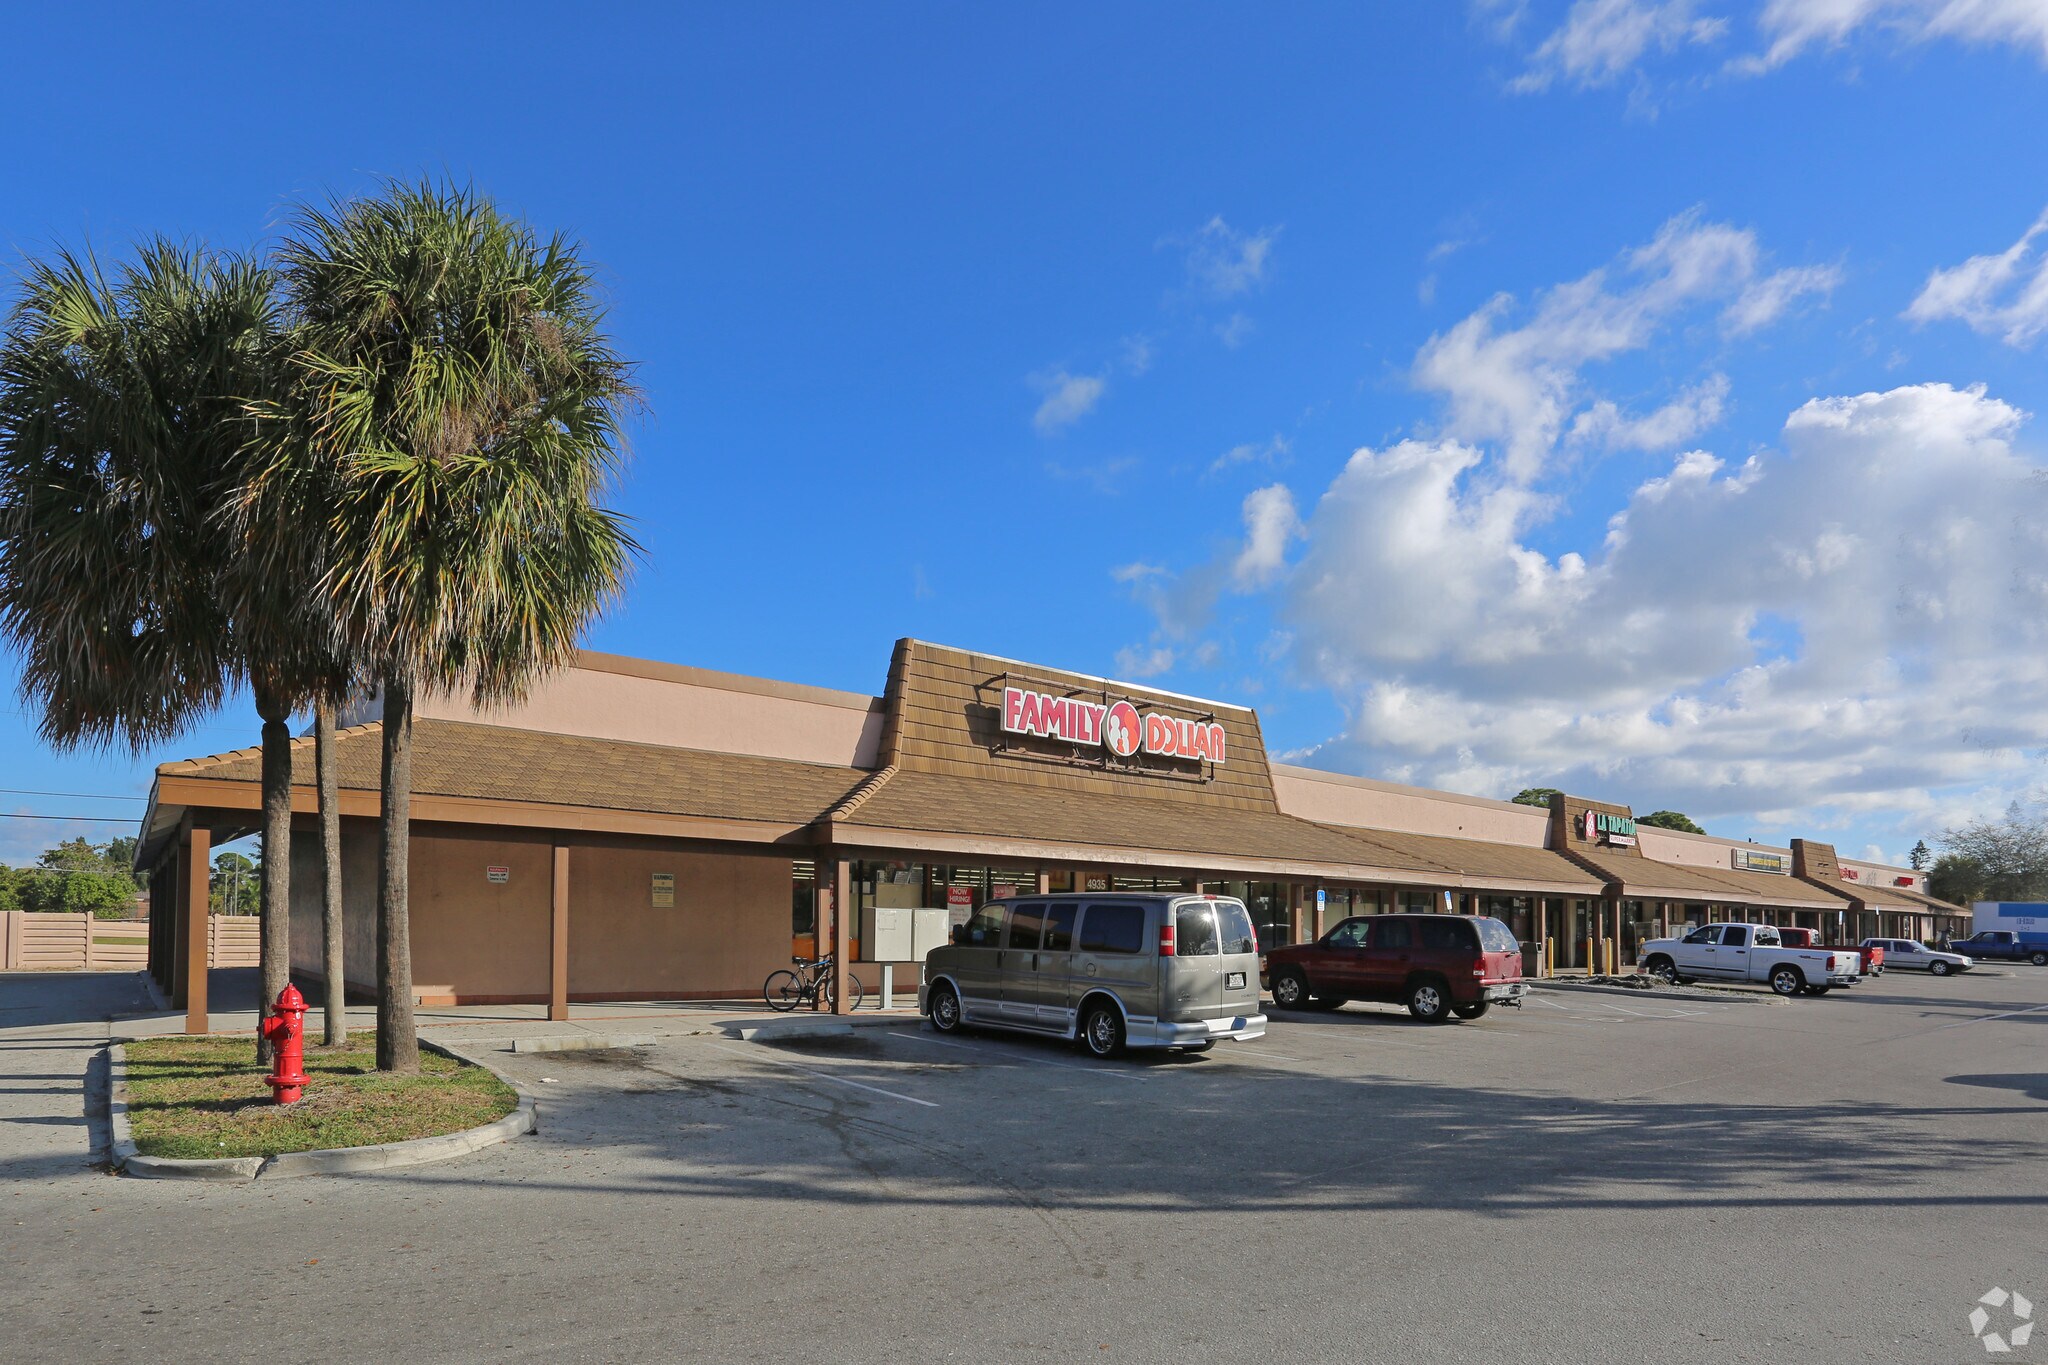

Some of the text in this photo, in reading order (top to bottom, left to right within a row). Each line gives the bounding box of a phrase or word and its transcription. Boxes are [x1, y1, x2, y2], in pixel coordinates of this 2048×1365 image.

[1005, 690, 1225, 762] FAMILY DOLLAR
[1597, 813, 1607, 832] LA
[1087, 878, 1106, 890] 4935
[949, 895, 971, 903] HIRING!
